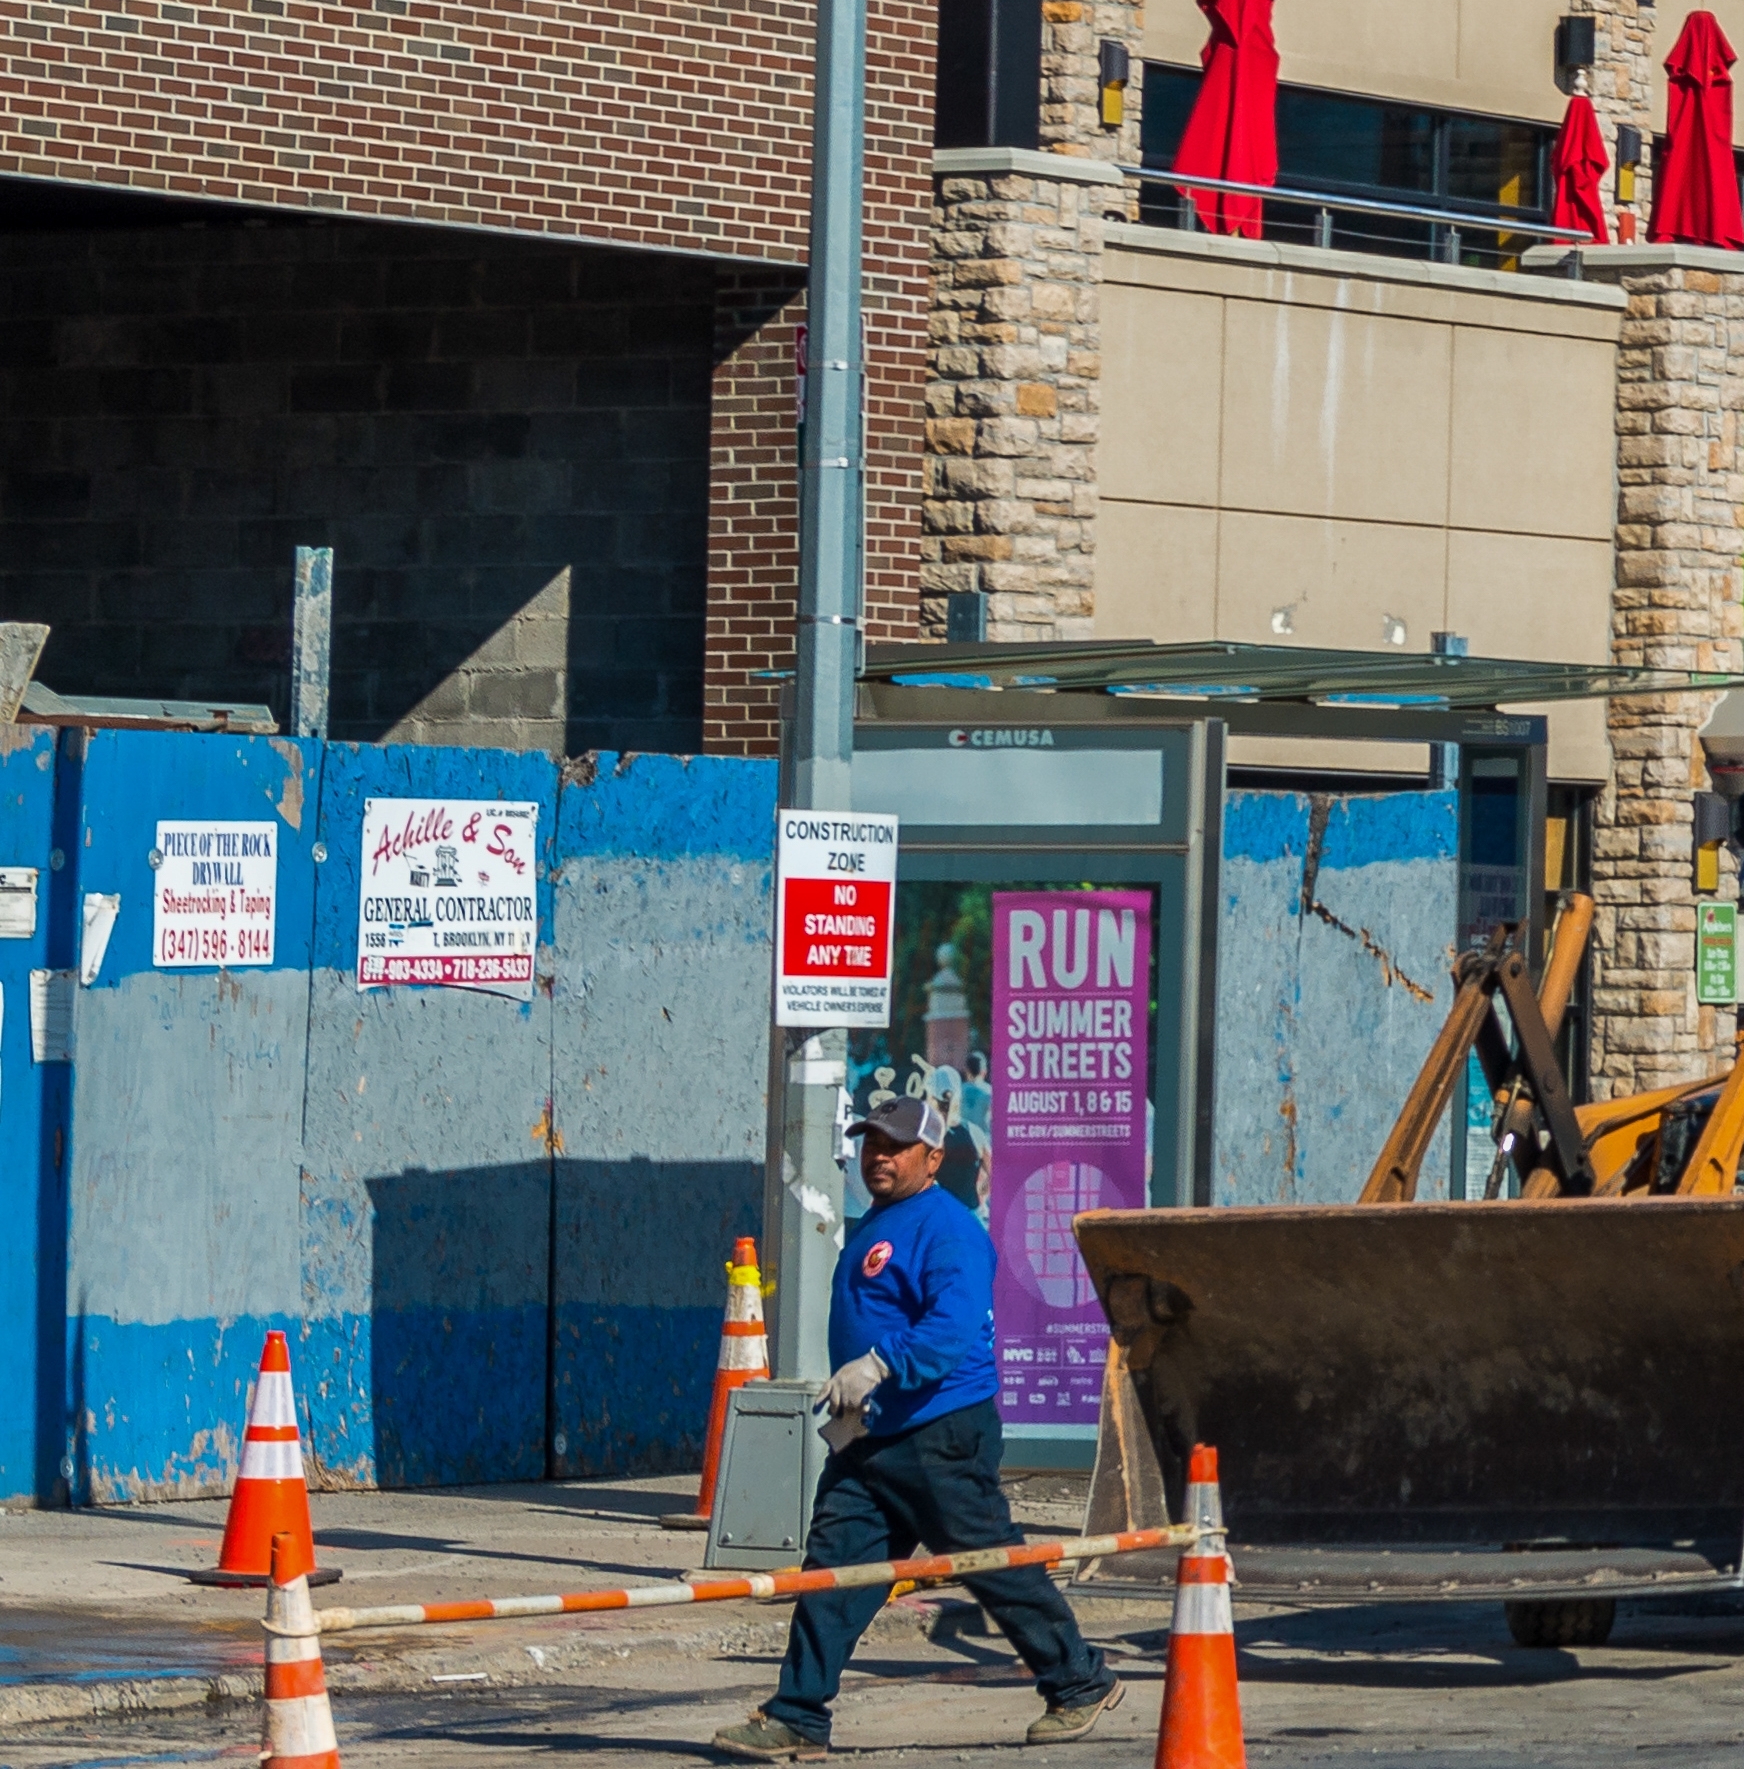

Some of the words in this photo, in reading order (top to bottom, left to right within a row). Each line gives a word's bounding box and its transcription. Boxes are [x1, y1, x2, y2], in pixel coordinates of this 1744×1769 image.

[971, 729, 1055, 746] CEMUSA
[164, 832, 198, 857] PIECE
[199, 832, 214, 857] OF
[215, 832, 239, 857] THE
[241, 833, 272, 858] ROCK
[373, 806, 453, 876] Achille
[462, 812, 482, 844] &
[486, 824, 526, 875] Son
[785, 820, 894, 845] CONSTRUCTION
[192, 861, 244, 886] DRYWALL
[827, 852, 866, 872] ZONE
[163, 888, 226, 921] Sheetrocking
[240, 888, 271, 921] Taping
[834, 885, 857, 906] NO
[364, 896, 431, 922] GENERAL
[435, 896, 533, 922] CONTRACTOR
[804, 914, 875, 937] STANDING
[162, 927, 199, 962] (347)
[807, 944, 841, 966] ANY
[843, 945, 872, 967] TIME
[1009, 908, 1136, 989] RUN
[1007, 999, 1132, 1040] SUMMER
[1007, 1041, 1132, 1080] STREETS
[1007, 1090, 1068, 1113] AUGUST
[1086, 1091, 1097, 1113] 8
[1115, 1090, 1132, 1113] 15
